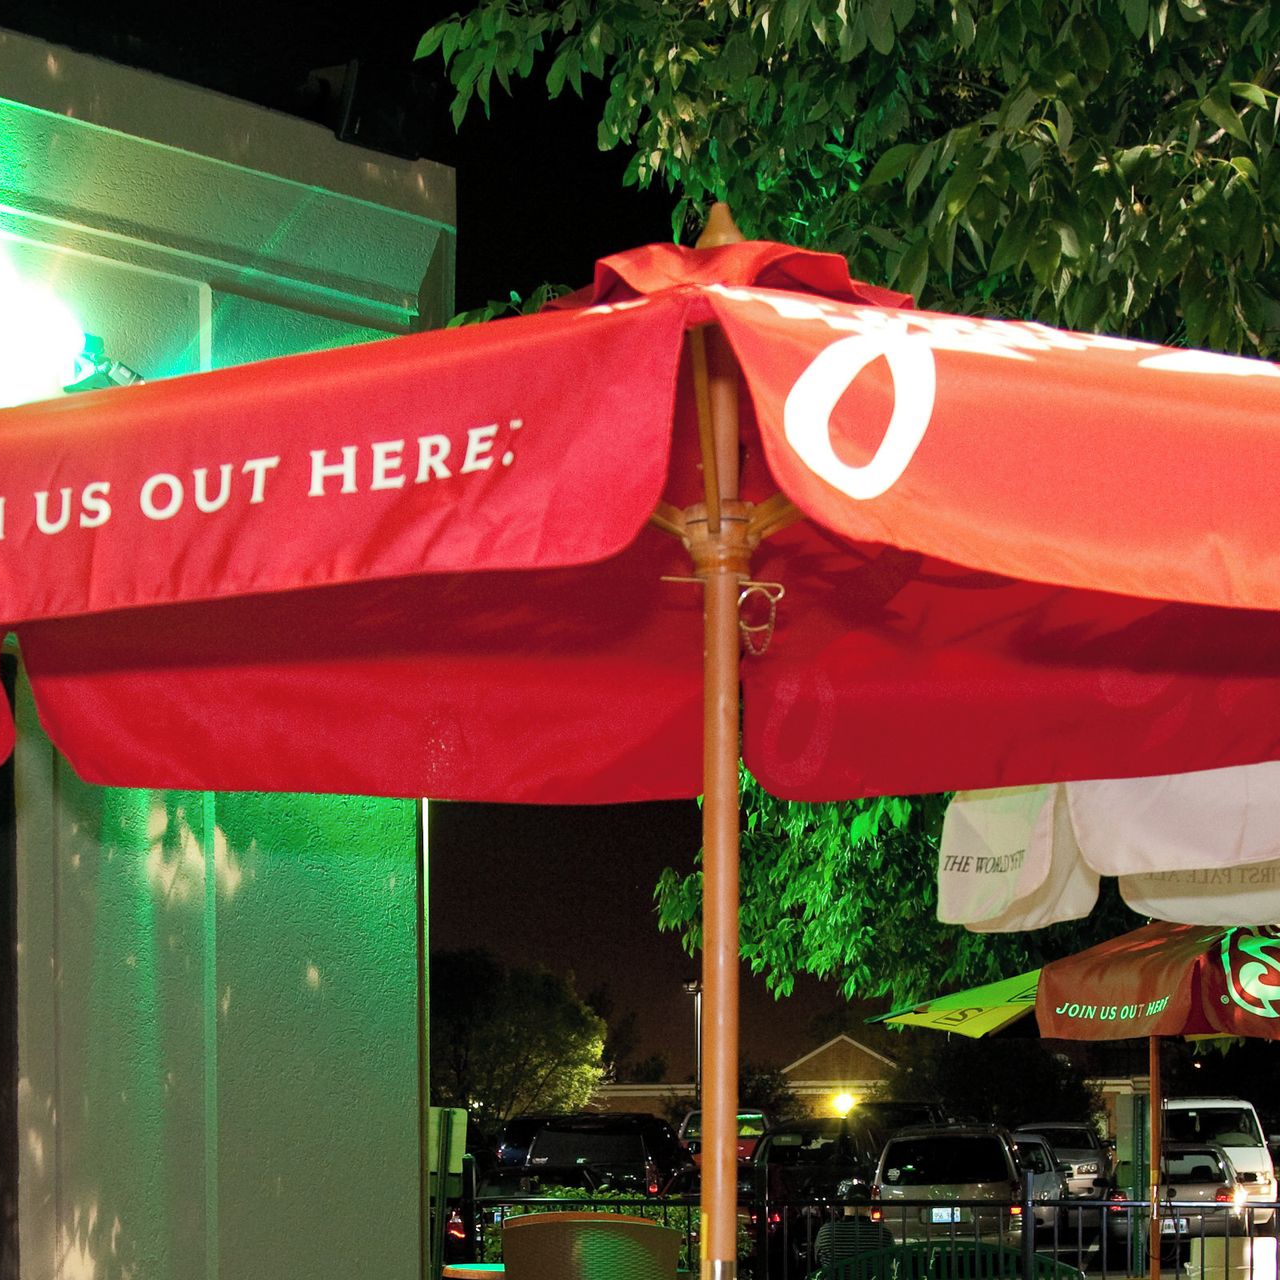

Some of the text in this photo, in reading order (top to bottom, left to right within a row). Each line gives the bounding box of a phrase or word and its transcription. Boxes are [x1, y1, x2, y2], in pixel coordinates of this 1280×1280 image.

[33, 480, 112, 534] US
[139, 456, 280, 522] OUT
[943, 855, 974, 873] THE
[1056, 1002, 1095, 1020] JOIN
[1099, 1005, 1117, 1021] US
[1120, 1003, 1146, 1020] OUT
